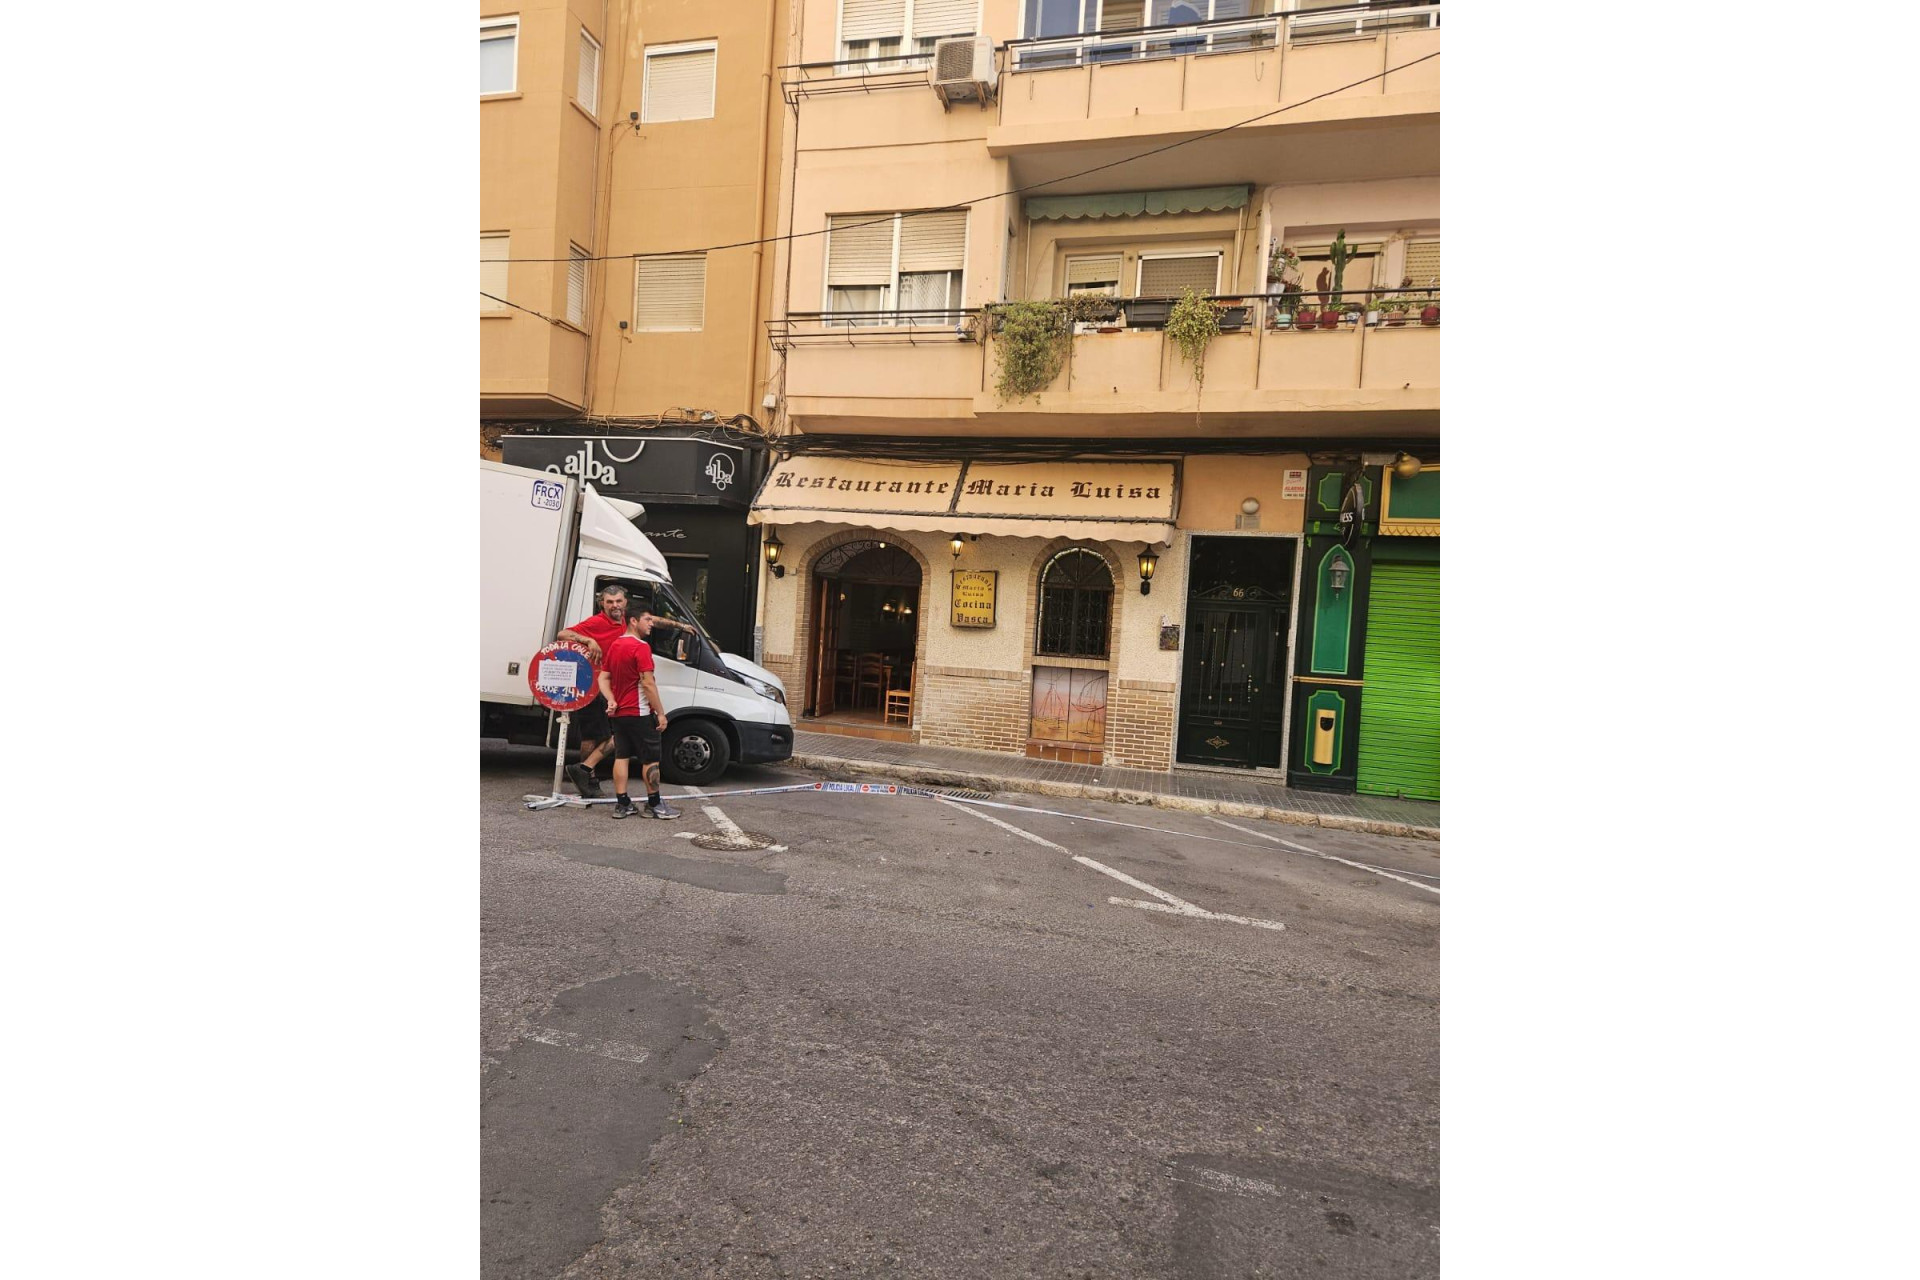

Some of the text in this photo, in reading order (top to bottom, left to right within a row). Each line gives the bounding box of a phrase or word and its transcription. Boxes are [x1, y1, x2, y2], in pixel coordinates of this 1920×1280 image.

[564, 440, 618, 490] alba
[705, 459, 733, 485] alba
[535, 484, 561, 500] FRCX
[774, 472, 1161, 499] Restaurante Maria Luisa
[1233, 587, 1245, 598] 66
[954, 598, 992, 610] Cocina
[956, 612, 989, 624] Vasca
[541, 642, 559, 656] TODA
[560, 641, 569, 650] LA
